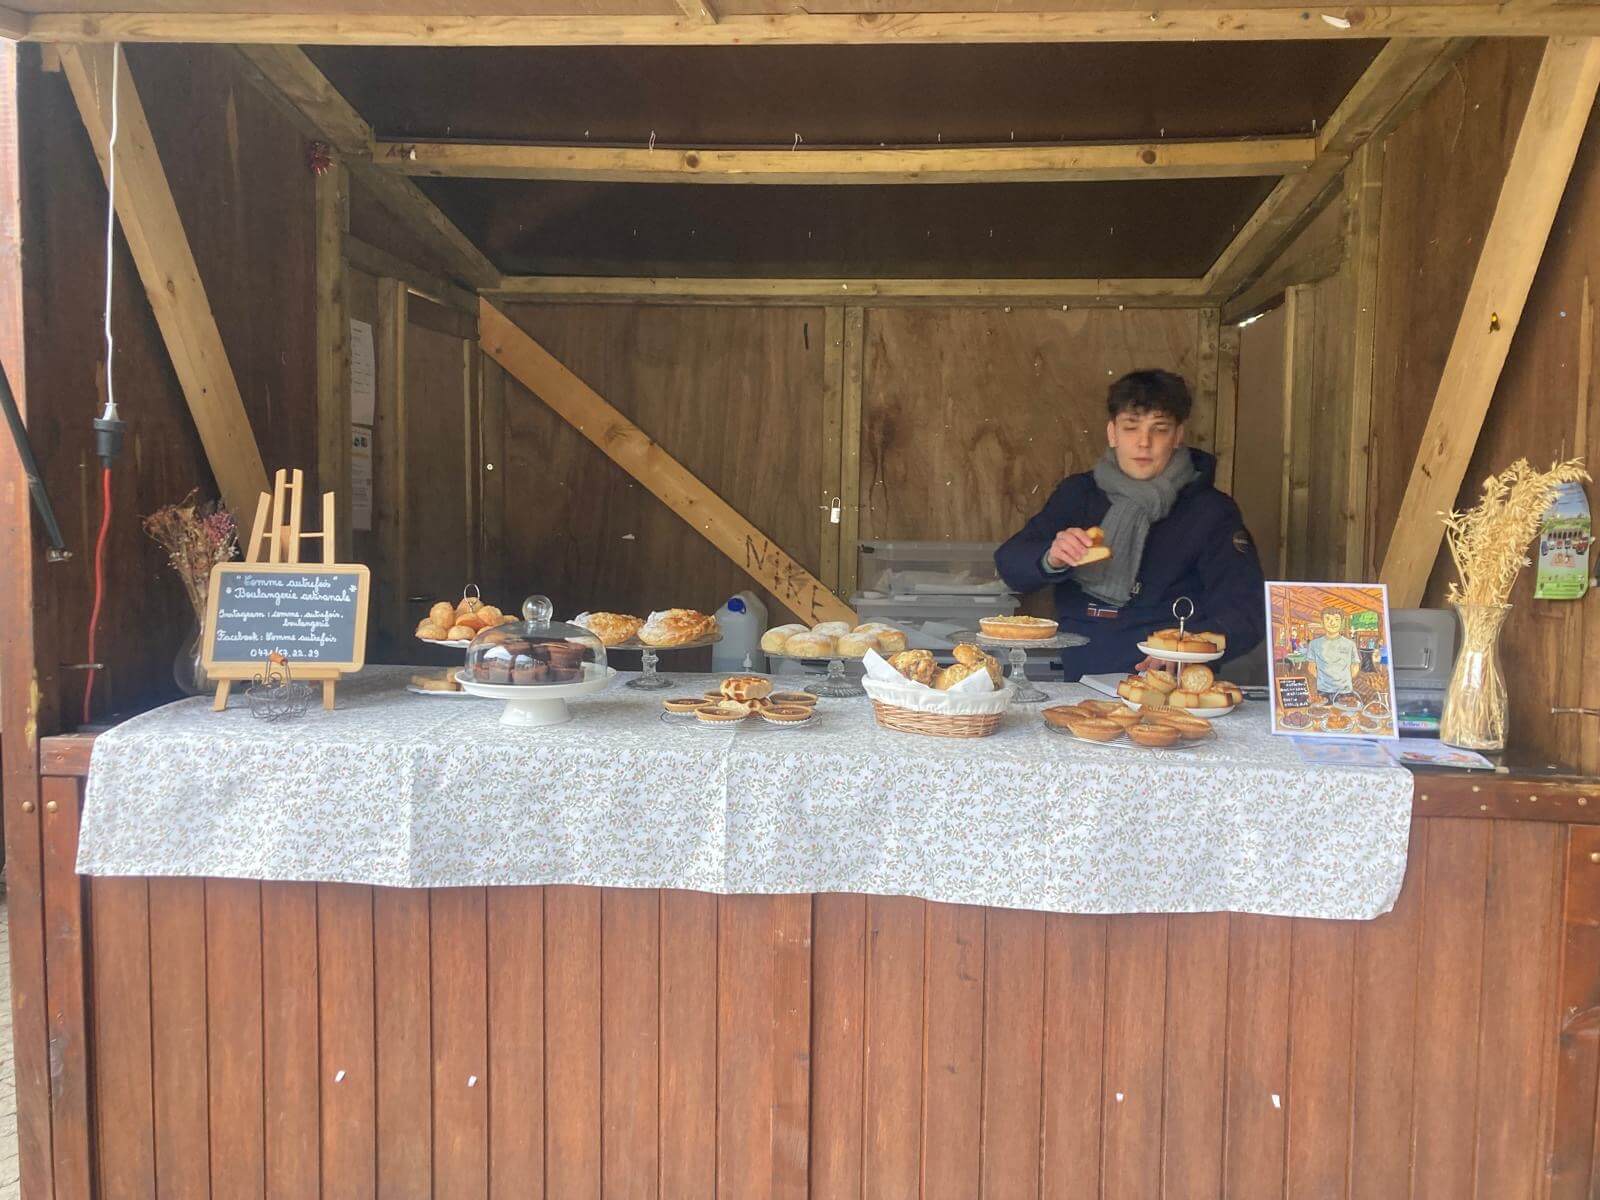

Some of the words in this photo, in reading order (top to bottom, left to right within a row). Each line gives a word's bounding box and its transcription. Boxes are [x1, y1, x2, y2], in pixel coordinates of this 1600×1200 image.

[234, 587, 298, 606] Boulangerie
[300, 589, 351, 602] artisanale
[282, 617, 330, 632] boulangerie
[265, 632, 296, 641] Comme
[297, 632, 337, 646] autrefois
